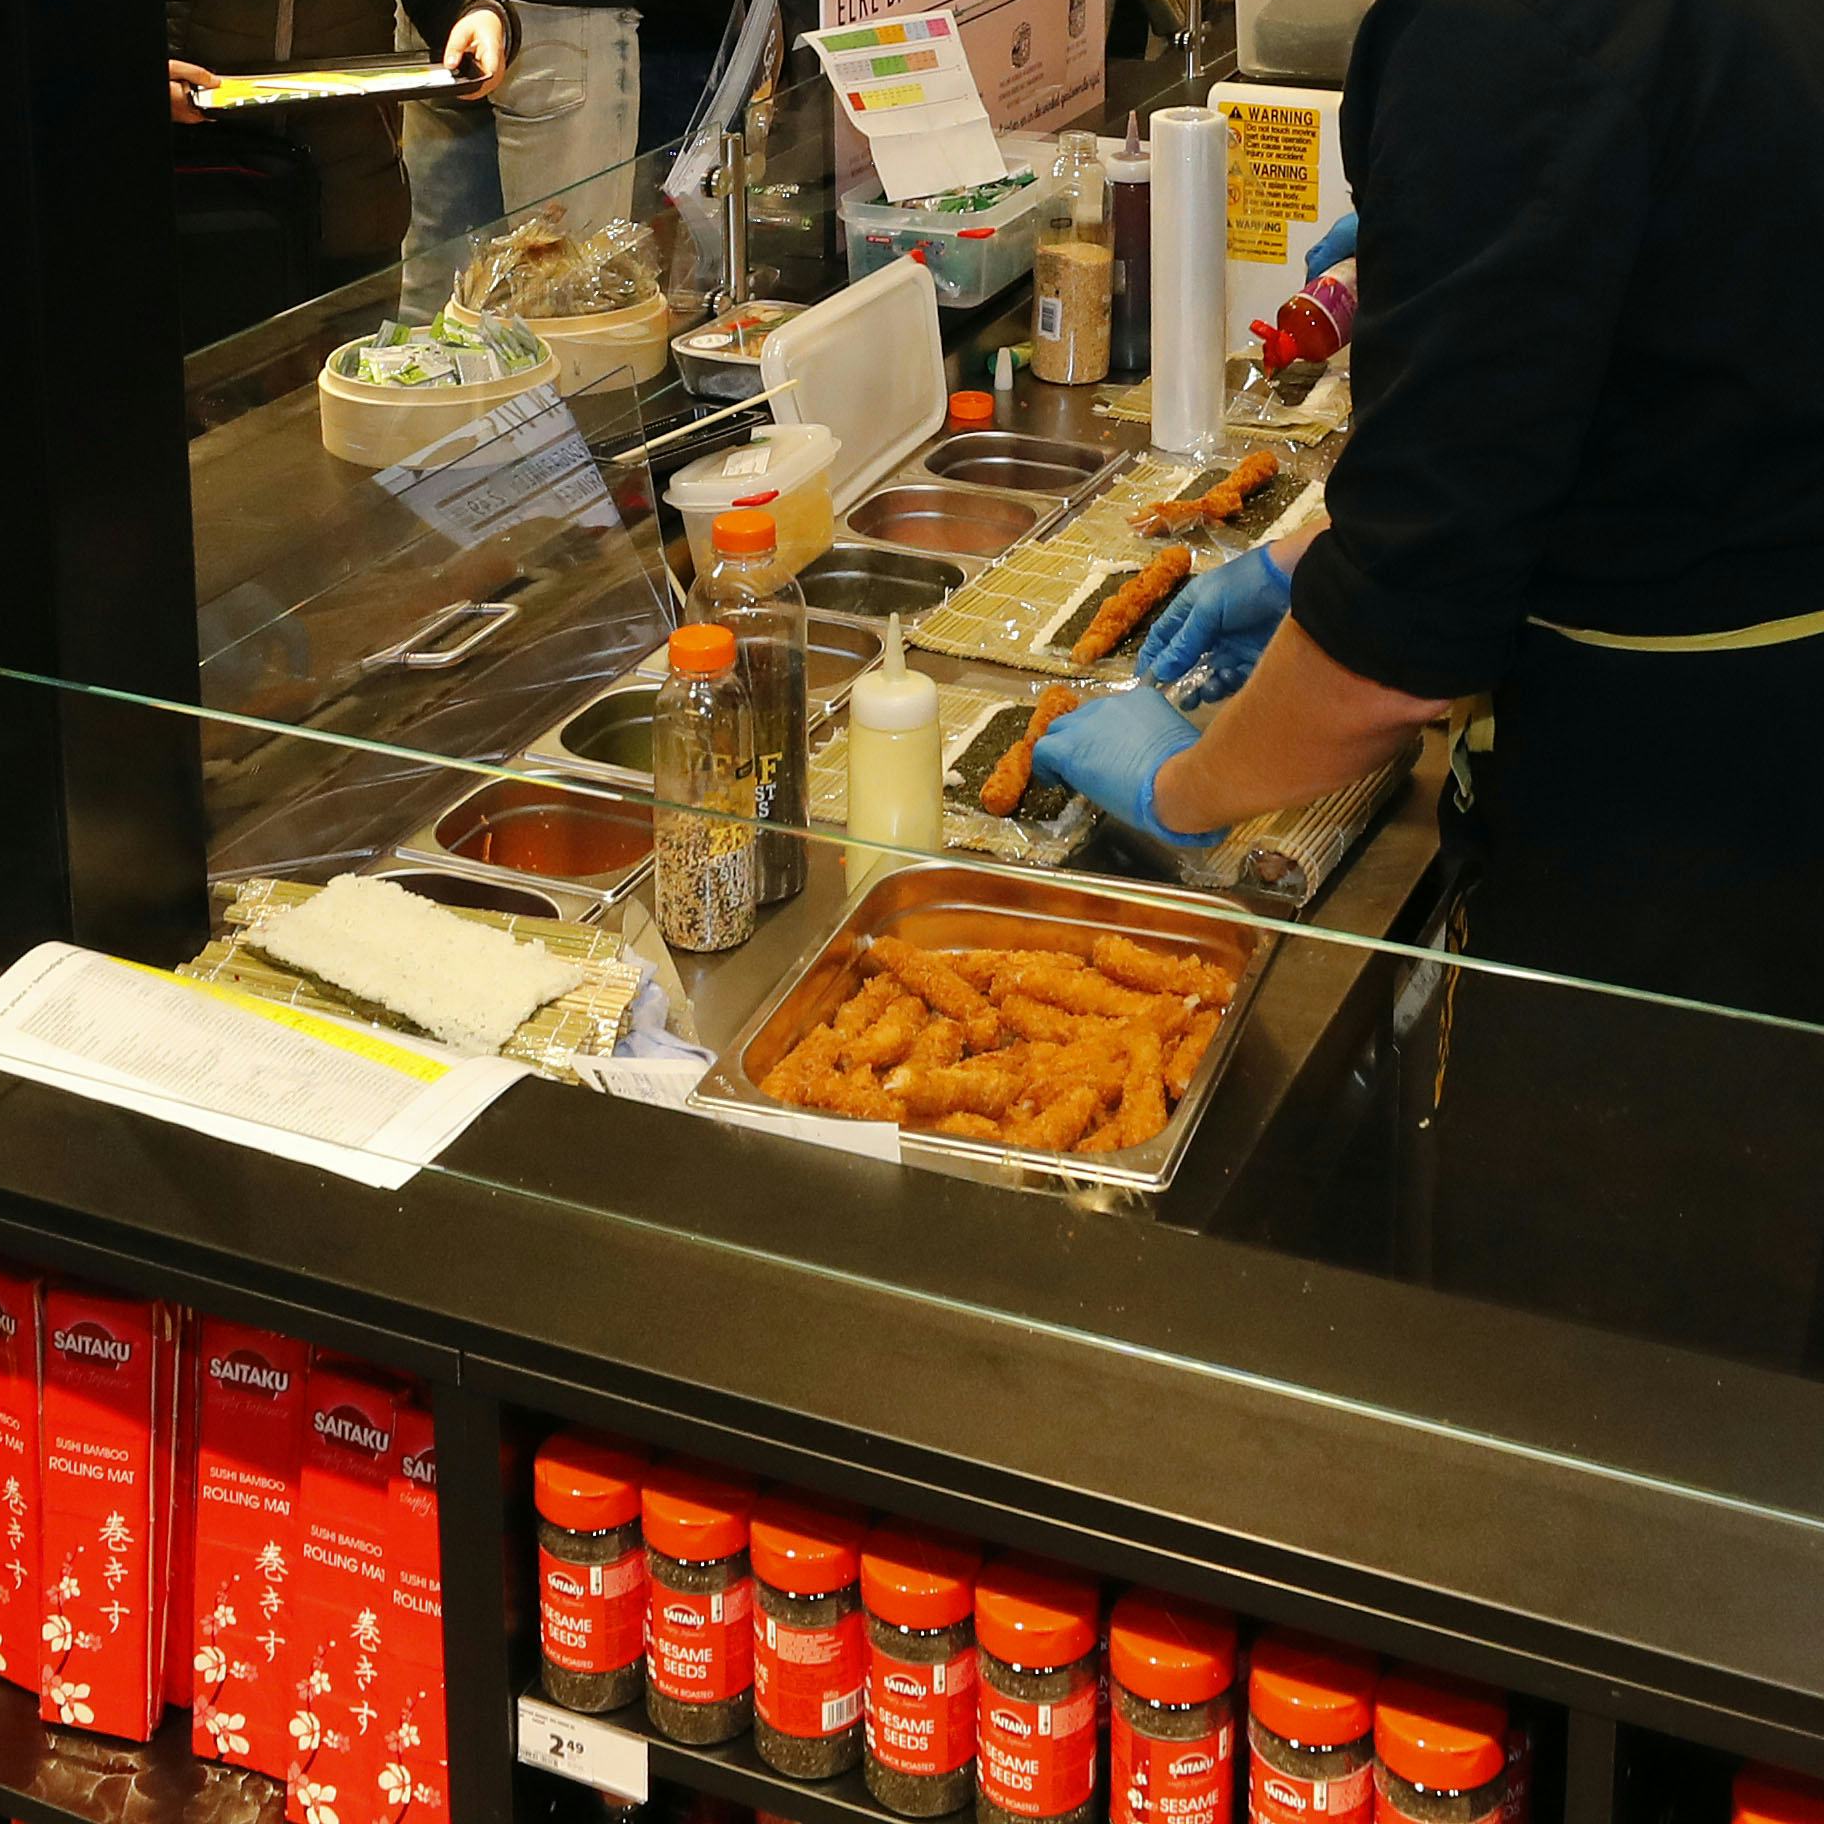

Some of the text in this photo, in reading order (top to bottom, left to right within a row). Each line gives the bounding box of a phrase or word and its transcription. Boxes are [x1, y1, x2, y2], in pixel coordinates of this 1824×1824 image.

[1248, 107, 1314, 126] WARNING
[1271, 126, 1291, 135] touch
[1250, 162, 1308, 180] WARNING
[54, 1330, 131, 1364] SAITAKU
[209, 1357, 289, 1393] SAITAKU
[4, 1433, 25, 1454] MAT
[313, 1411, 389, 1454] SAITAKU
[55, 1437, 129, 1462] SUSHI BAMBOO
[48, 1456, 135, 1485] ROLLING MAT
[209, 1466, 285, 1493] SUSHI BAMBOO
[202, 1485, 291, 1517] ROLLING MAT
[1, 1475, 28, 1591] 巻きす
[310, 1524, 383, 1558] SUSHI BAMBOO
[98, 1510, 135, 1634] 巻きす
[303, 1542, 386, 1583] ROLLING MAT
[399, 1570, 426, 1590] SUSHI
[546, 1572, 585, 1598] SAITAKU
[255, 1539, 289, 1663] 巻きす
[545, 1607, 592, 1634] SESAME
[663, 1604, 705, 1629] SAITAKU
[547, 1624, 587, 1650] SEEDS
[658, 1637, 713, 1663] SESAME
[350, 1607, 382, 1736] 巻きす
[567, 1654, 594, 1669] ROASTED
[663, 1656, 707, 1680] SEEDS
[681, 1686, 714, 1700] ROASTED
[883, 1673, 927, 1697] SAITAKU
[878, 1708, 935, 1734] SESAME
[990, 1711, 1032, 1737] SAITAKU
[884, 1726, 929, 1751] SEEDS
[985, 1742, 1039, 1776] SESAME
[1168, 1754, 1214, 1777] SAITAKU
[989, 1764, 1033, 1792] SEEDS
[1160, 1790, 1219, 1815] SESAME
[1264, 1783, 1307, 1812] SAITAKU
